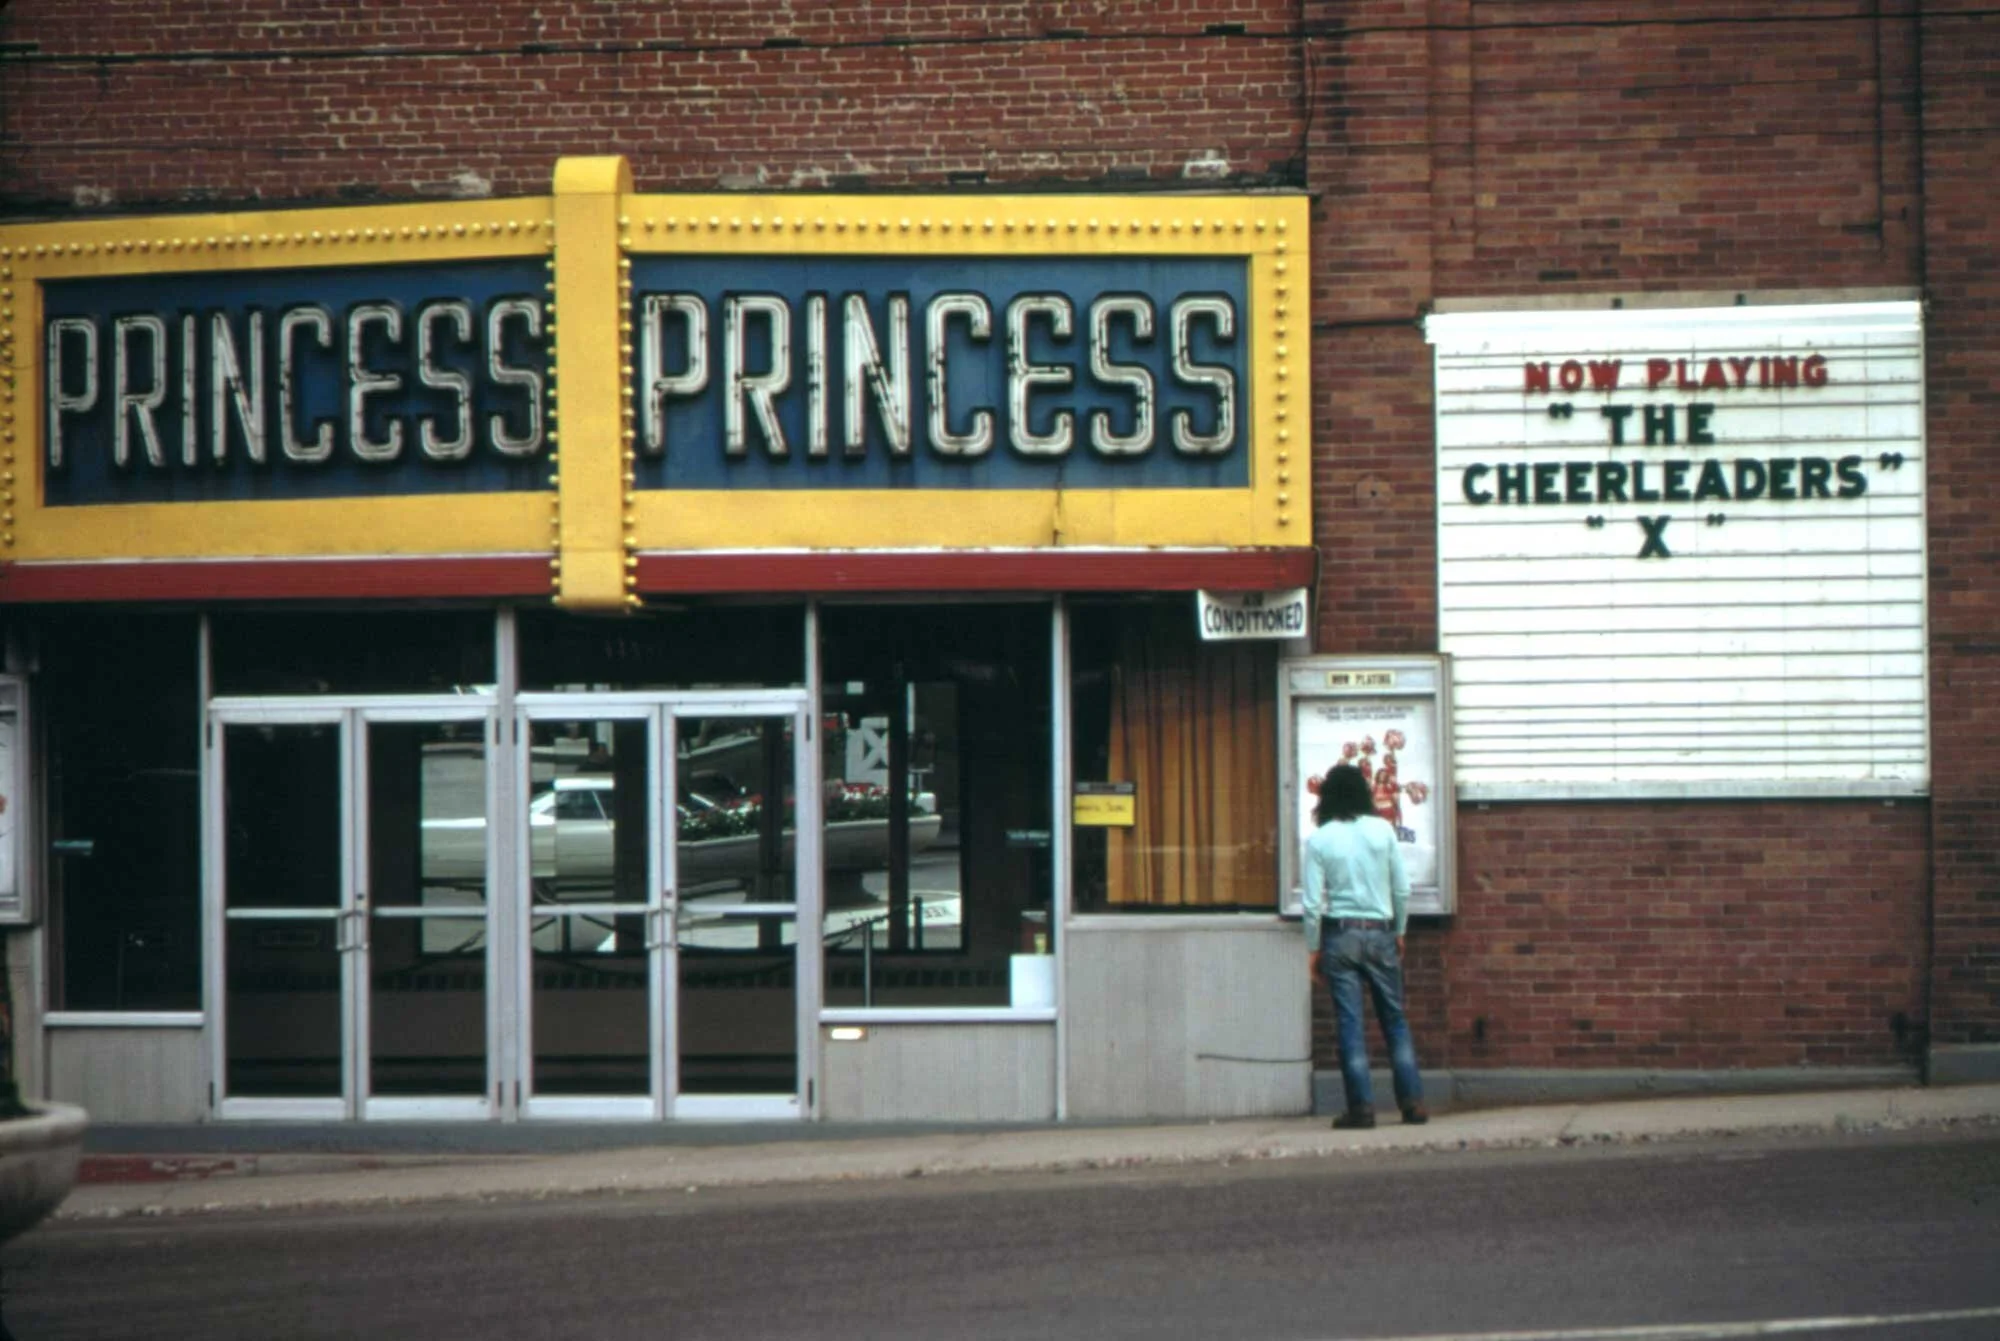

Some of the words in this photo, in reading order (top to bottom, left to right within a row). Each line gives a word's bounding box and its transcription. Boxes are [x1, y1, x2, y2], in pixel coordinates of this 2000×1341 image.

[46, 296, 545, 469] PRINCESS
[639, 290, 1238, 457] PRINCESS
[1524, 359, 1622, 394] NOW
[1647, 354, 1829, 391] PLAYING
[1204, 601, 1304, 634] CONDITIONED
